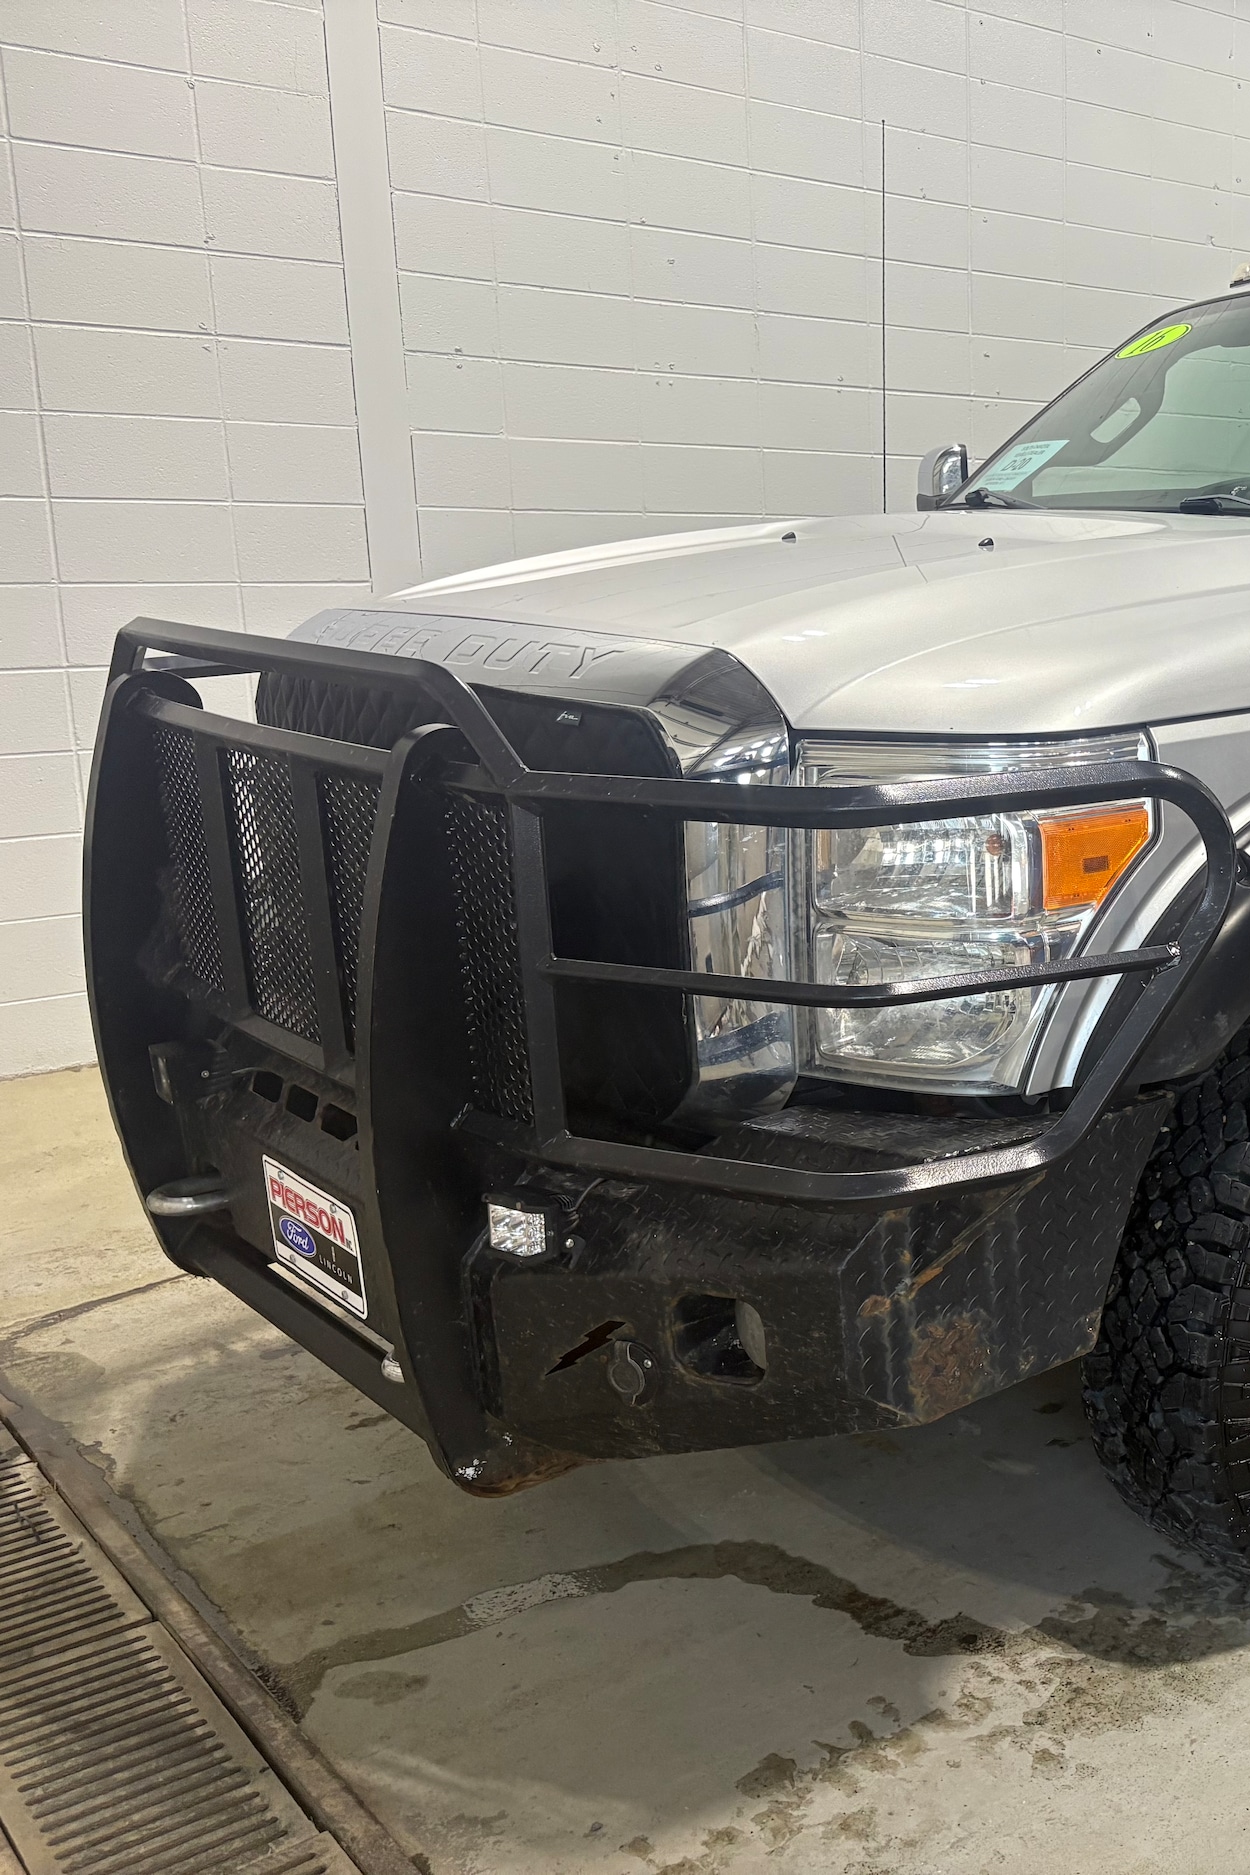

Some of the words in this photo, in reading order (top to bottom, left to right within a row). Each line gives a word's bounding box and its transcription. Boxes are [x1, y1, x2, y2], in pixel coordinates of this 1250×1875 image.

[443, 633, 625, 679] DUTY
[269, 1174, 346, 1246] PIERSON
[286, 1221, 309, 1250] Ford
[319, 1254, 353, 1284] LINCOLN
